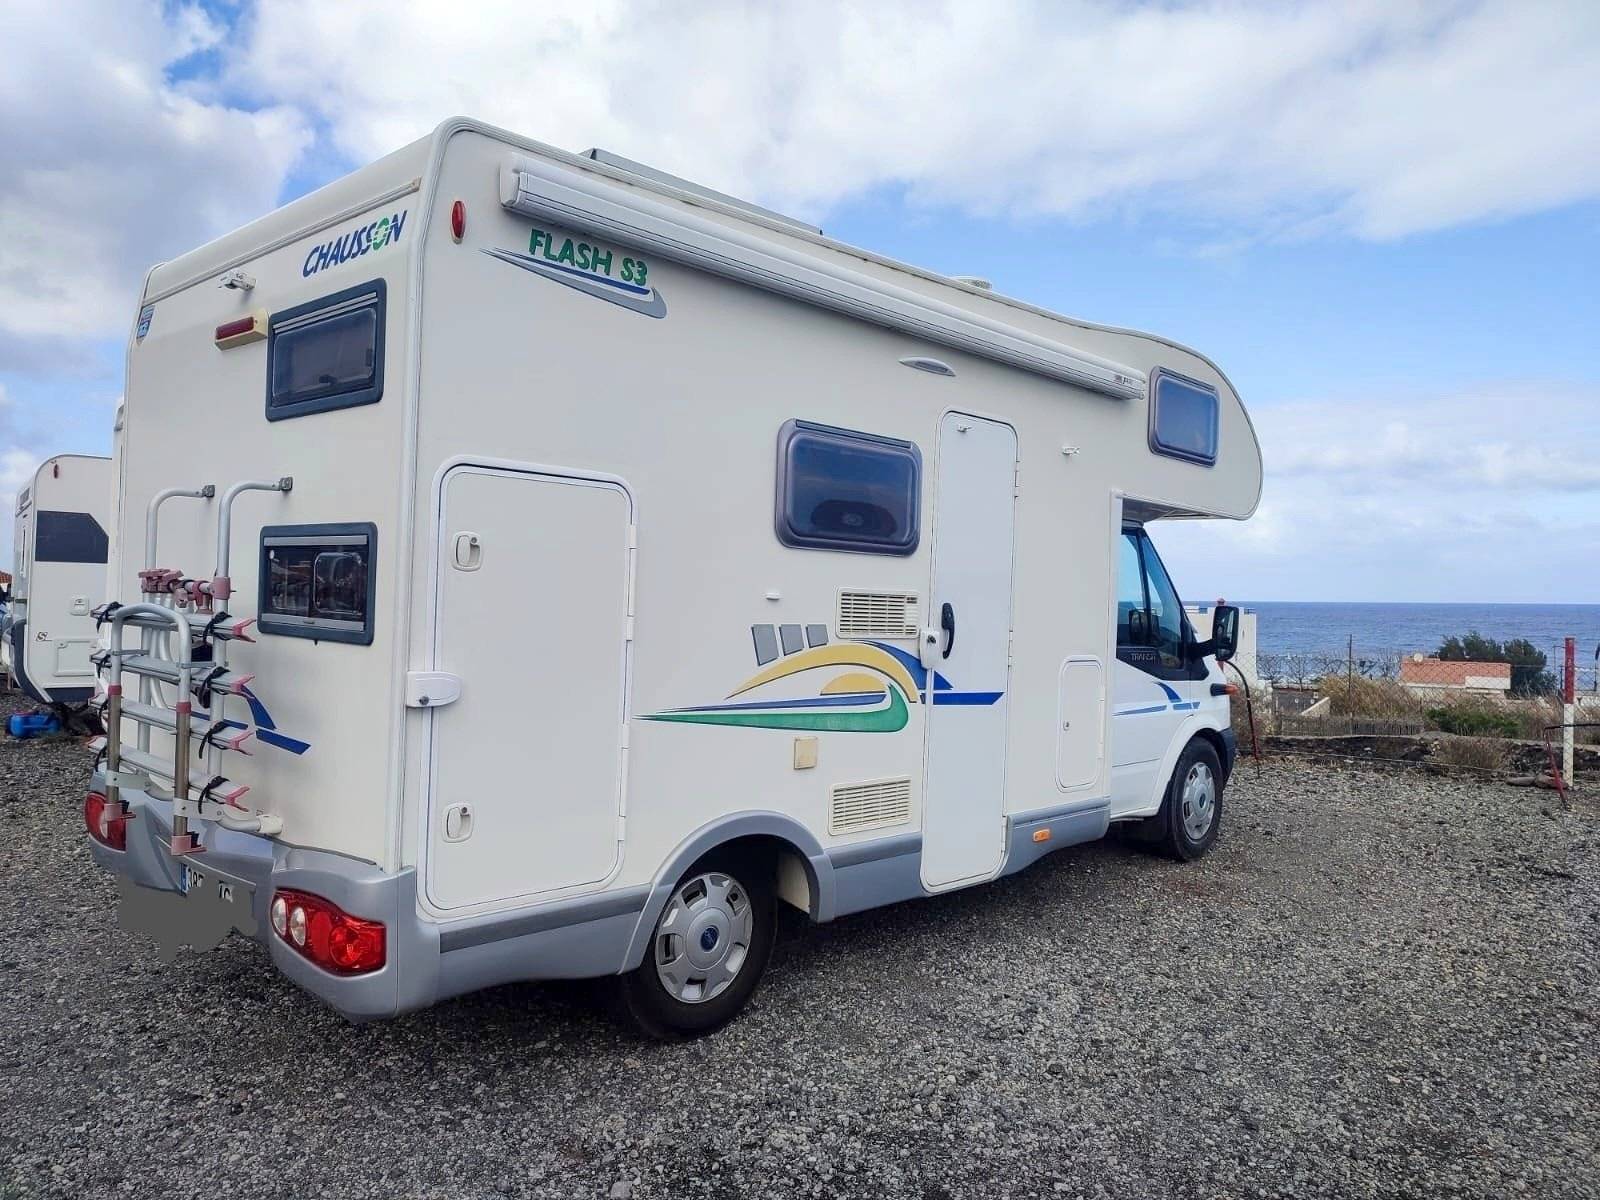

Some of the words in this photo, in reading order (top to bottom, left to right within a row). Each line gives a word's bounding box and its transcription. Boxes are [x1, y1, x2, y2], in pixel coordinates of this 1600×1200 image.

[303, 210, 407, 277] CHAUSSON
[529, 228, 613, 276] FLASH
[620, 257, 648, 286] S3
